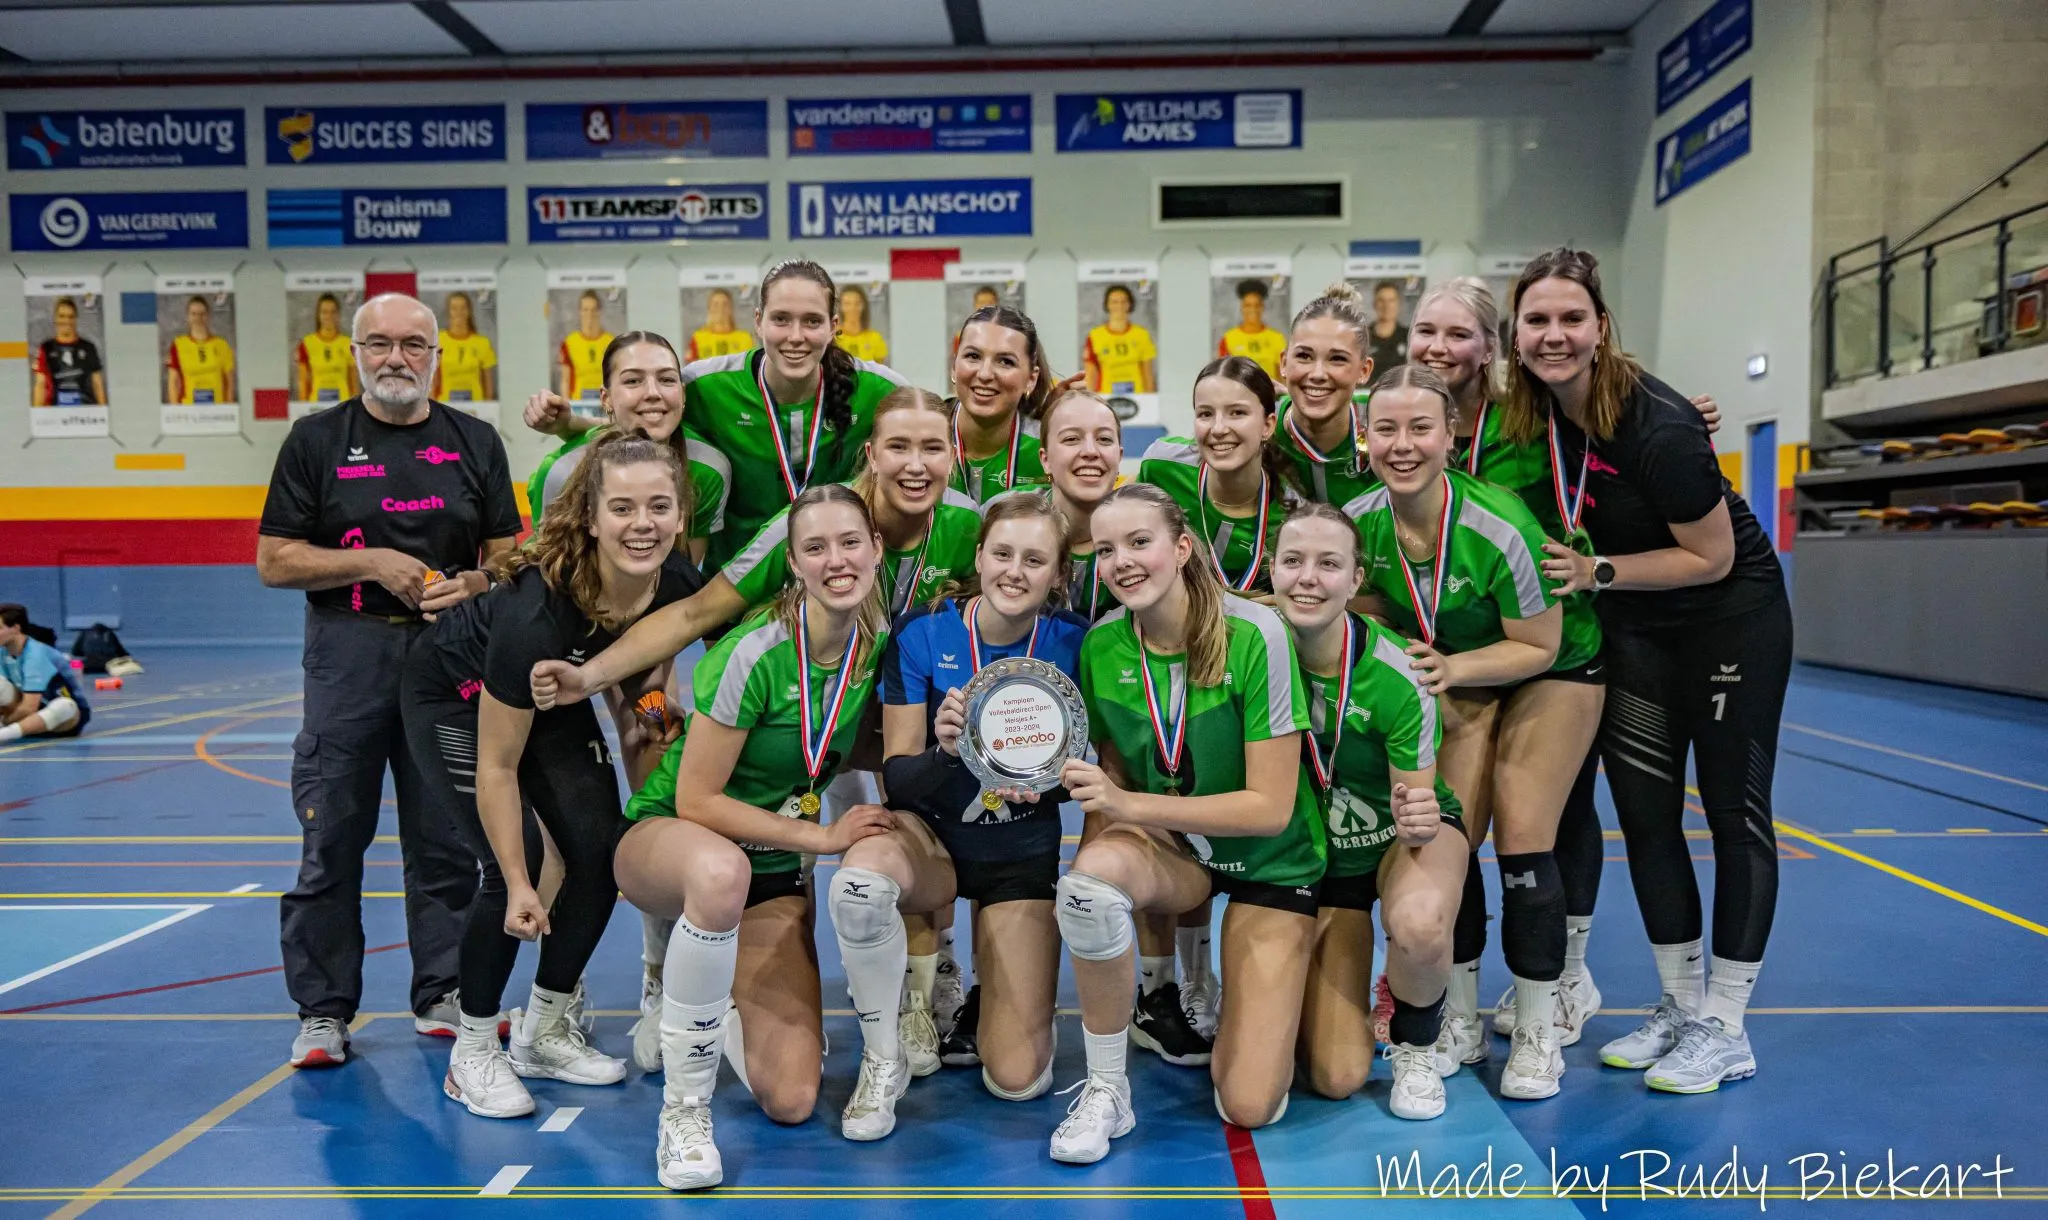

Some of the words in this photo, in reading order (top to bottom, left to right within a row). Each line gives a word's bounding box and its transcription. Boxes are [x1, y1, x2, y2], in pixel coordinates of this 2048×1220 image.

[794, 105, 934, 128] vandenberg
[1122, 100, 1224, 121] VELDHUIS
[78, 115, 235, 154] batenburg
[318, 121, 412, 149] SUCCES
[422, 119, 494, 147] SIGNS
[1122, 122, 1197, 142] ADVIES
[354, 196, 451, 218] Draisma
[832, 195, 885, 217] VAN
[890, 191, 1021, 215] LANSCHOT
[97, 214, 130, 231] VAN
[130, 212, 217, 231] GERREVINK
[354, 219, 421, 238] Bouw
[833, 214, 936, 235] KEMPEN
[381, 495, 445, 513] Coach
[1710, 674, 1742, 682] erima
[989, 706, 1034, 717] Volleybaldirect
[1035, 704, 1051, 713] Open
[1003, 697, 1035, 706] Kampioen
[1711, 692, 1727, 721] 1
[1004, 716, 1028, 724] Meisjes
[1004, 724, 1041, 734] 2023-2024
[1005, 732, 1056, 746] nevobo
[1332, 824, 1397, 849] BERENKU
